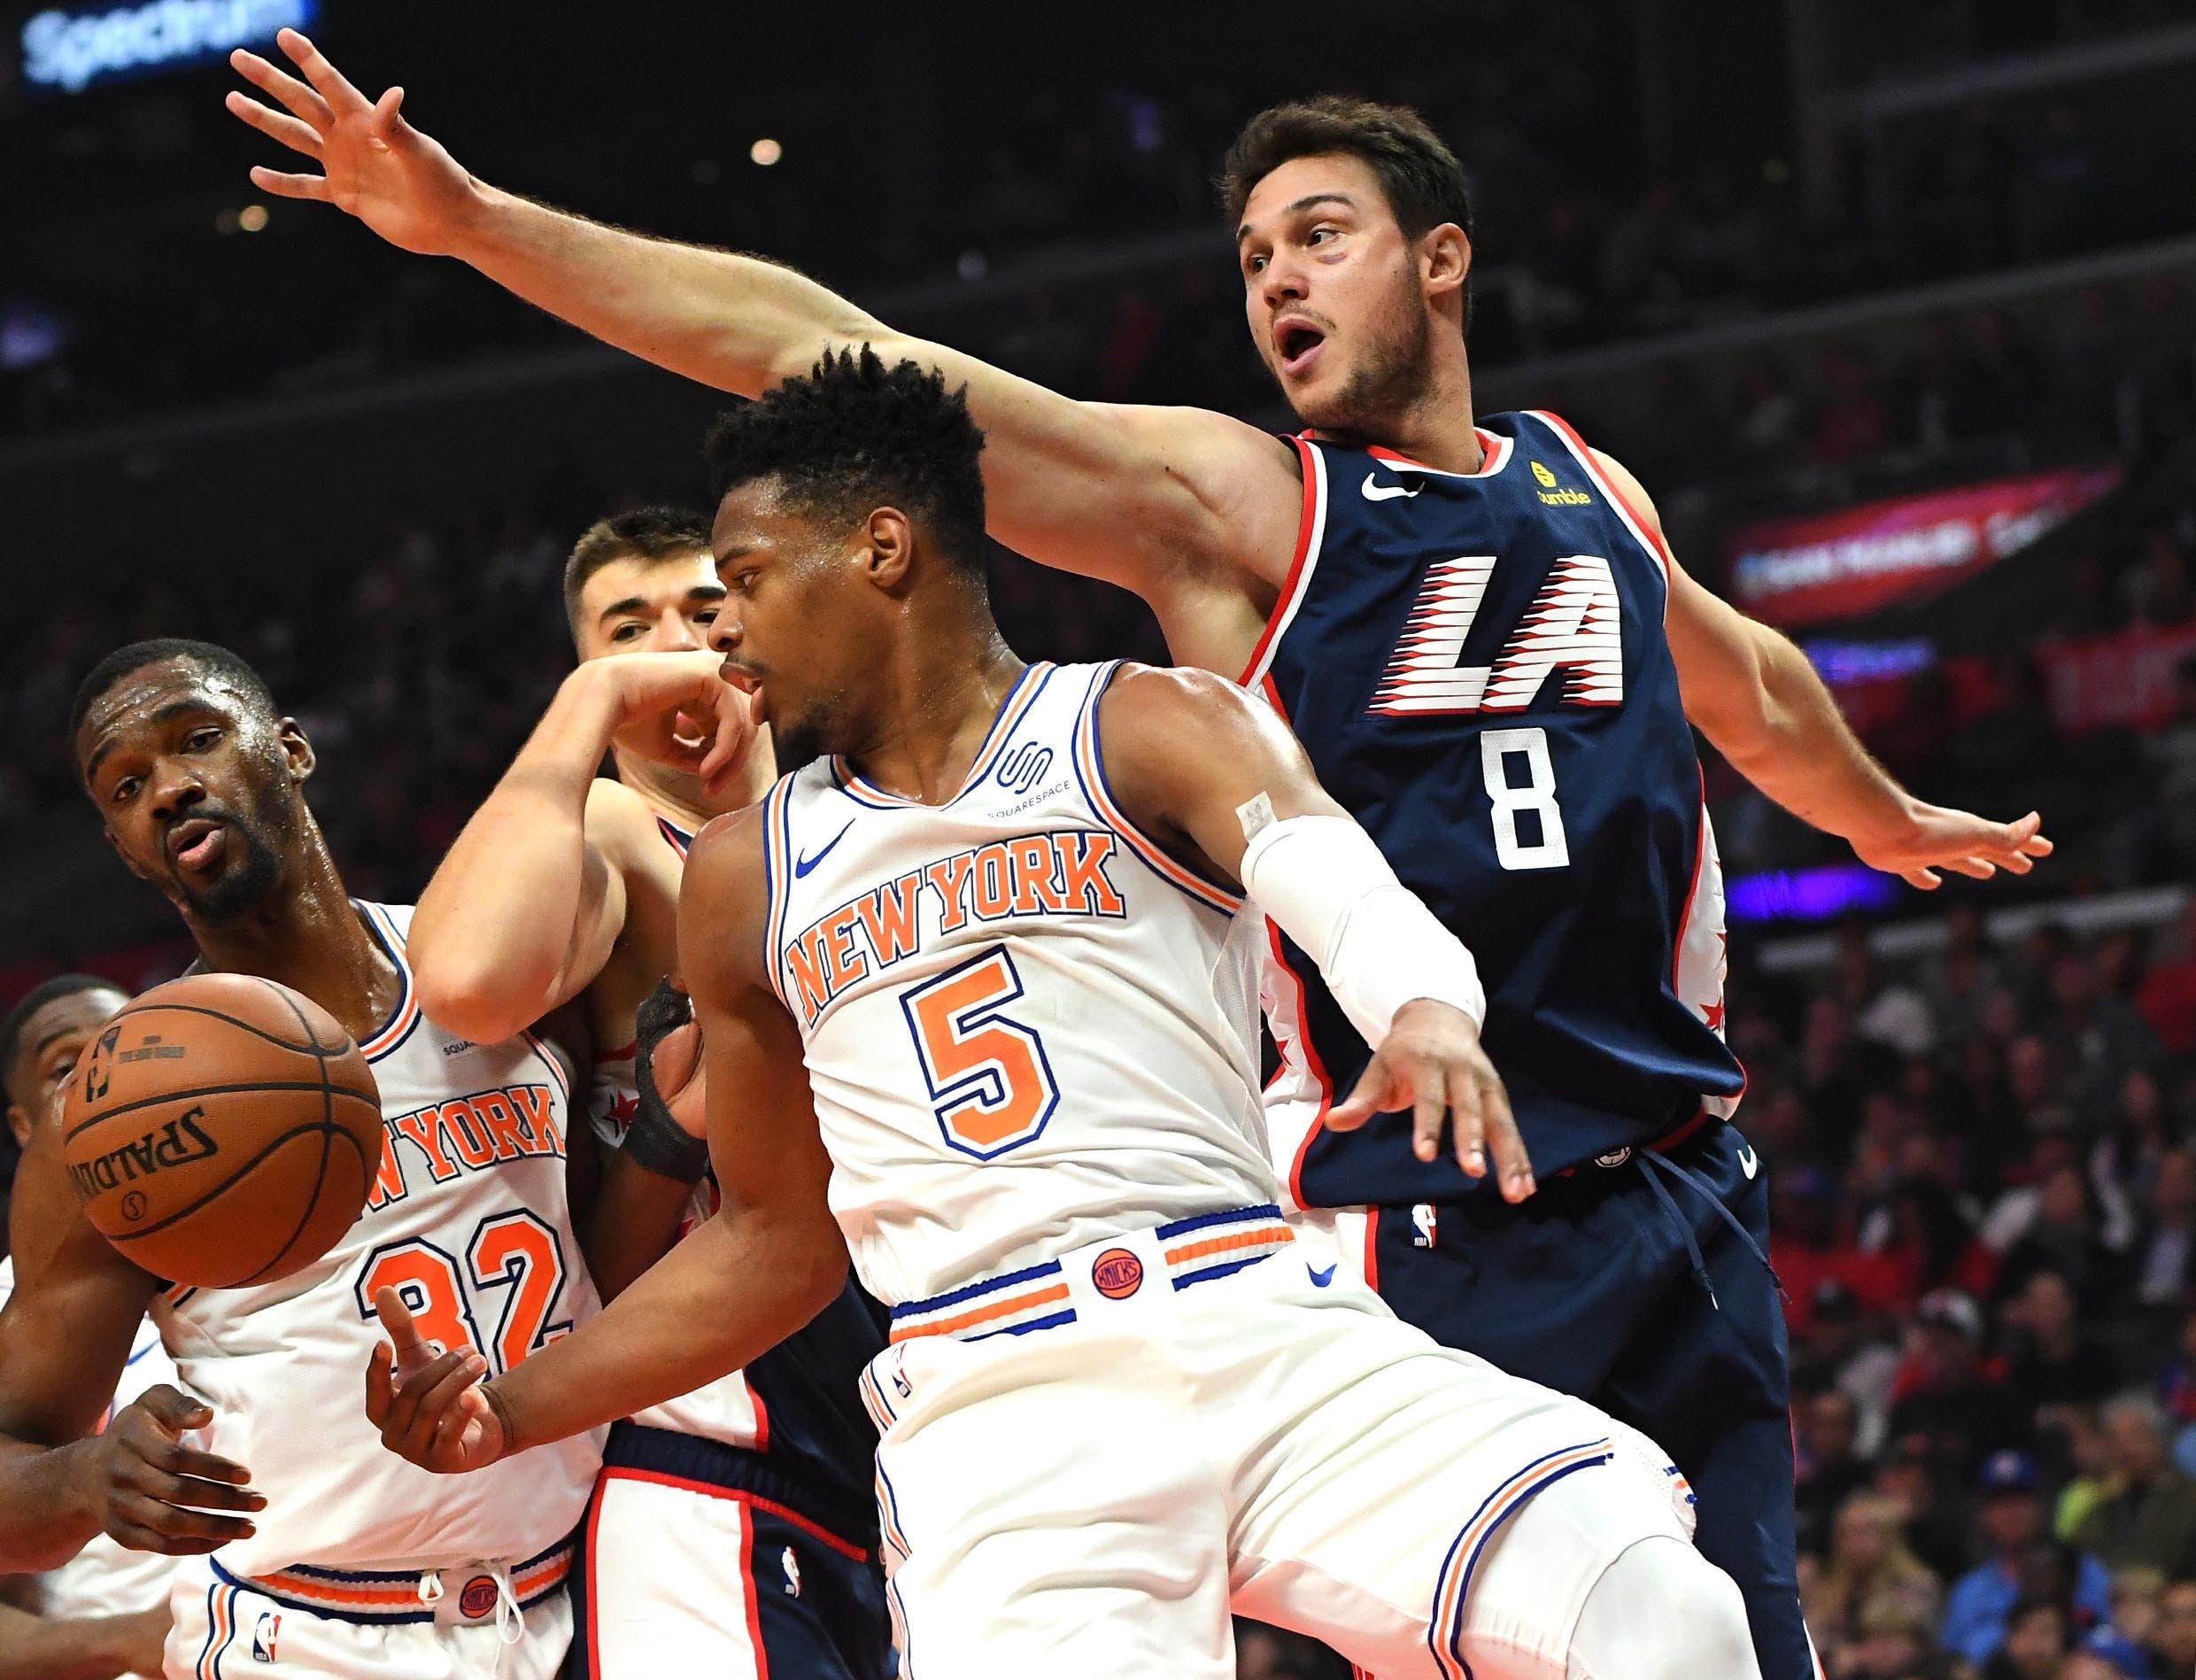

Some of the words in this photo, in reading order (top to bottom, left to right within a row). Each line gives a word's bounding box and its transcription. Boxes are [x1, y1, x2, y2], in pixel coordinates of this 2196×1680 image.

[1364, 554, 1623, 716] LA
[987, 780, 1071, 818] SQUARESPACE
[1481, 727, 1570, 871] 8
[785, 867, 924, 1029] NEW
[926, 830, 1126, 935] YORK
[900, 943, 1061, 1161] 5
[391, 1084, 568, 1185] YORK
[1097, 1260, 1139, 1287] KNICKS
